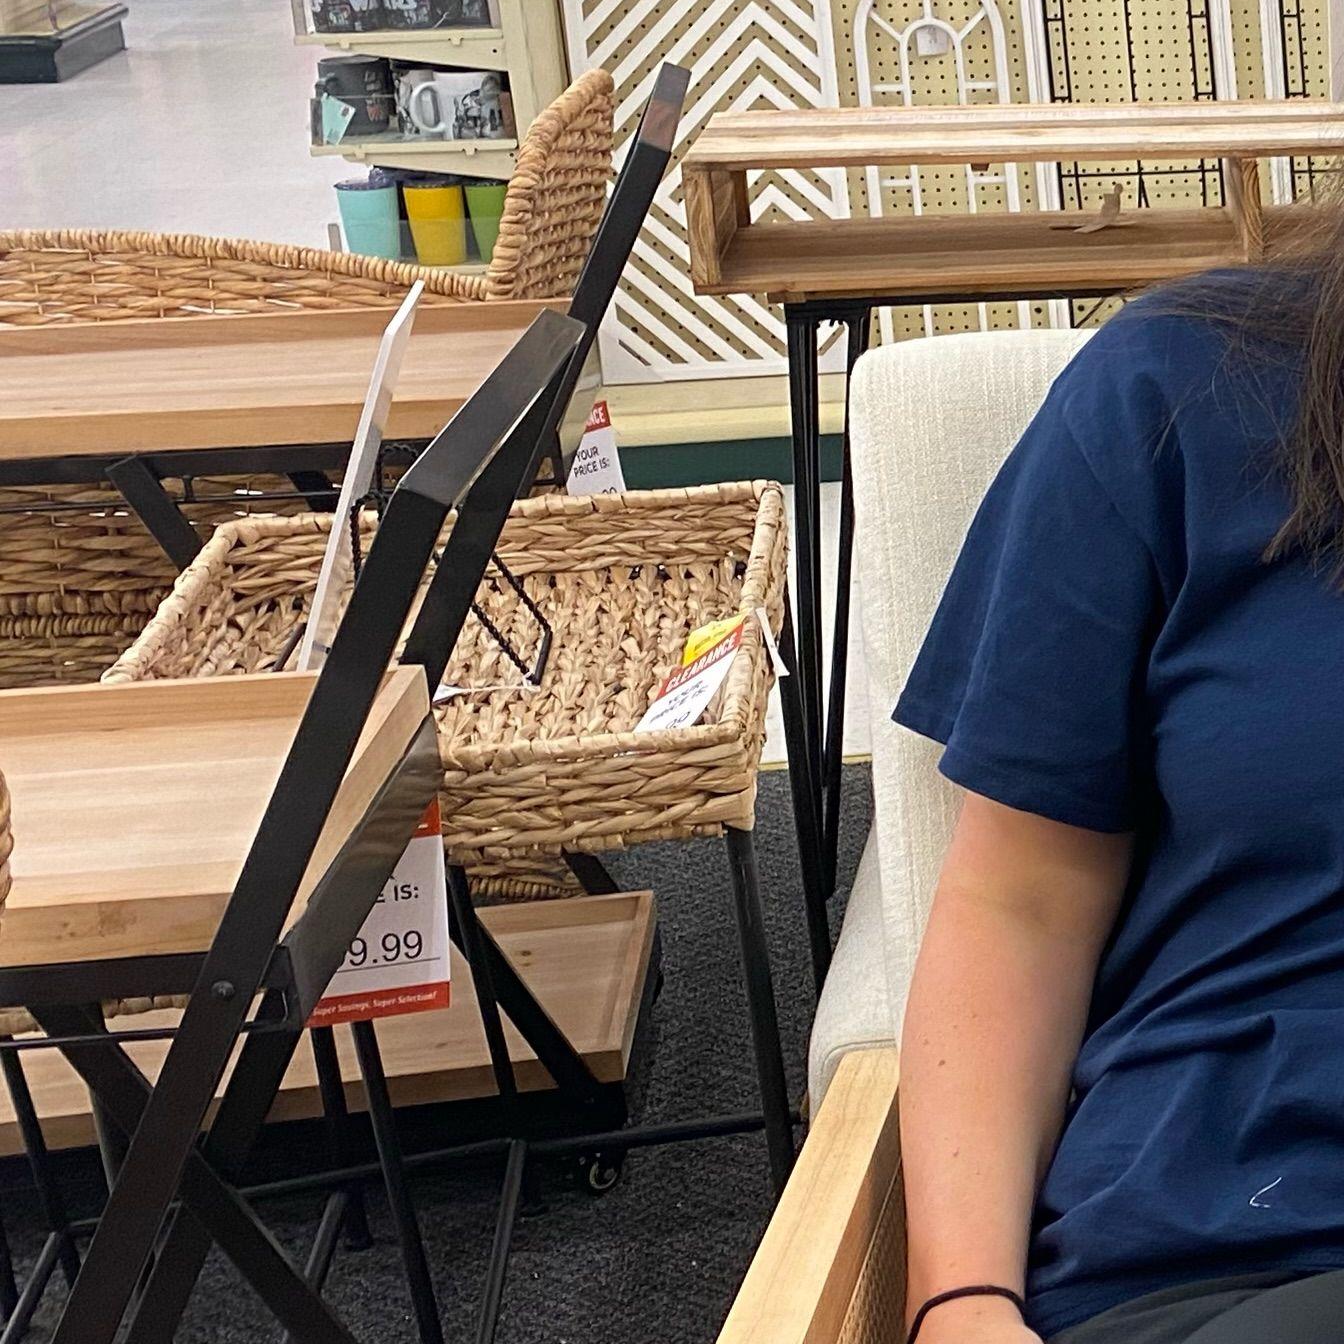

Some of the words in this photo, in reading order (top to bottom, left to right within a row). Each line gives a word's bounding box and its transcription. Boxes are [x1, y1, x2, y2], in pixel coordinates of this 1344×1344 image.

[573, 460, 599, 477] PRICE
[664, 630, 738, 693] CLEARANCE
[394, 884, 419, 902] IS:
